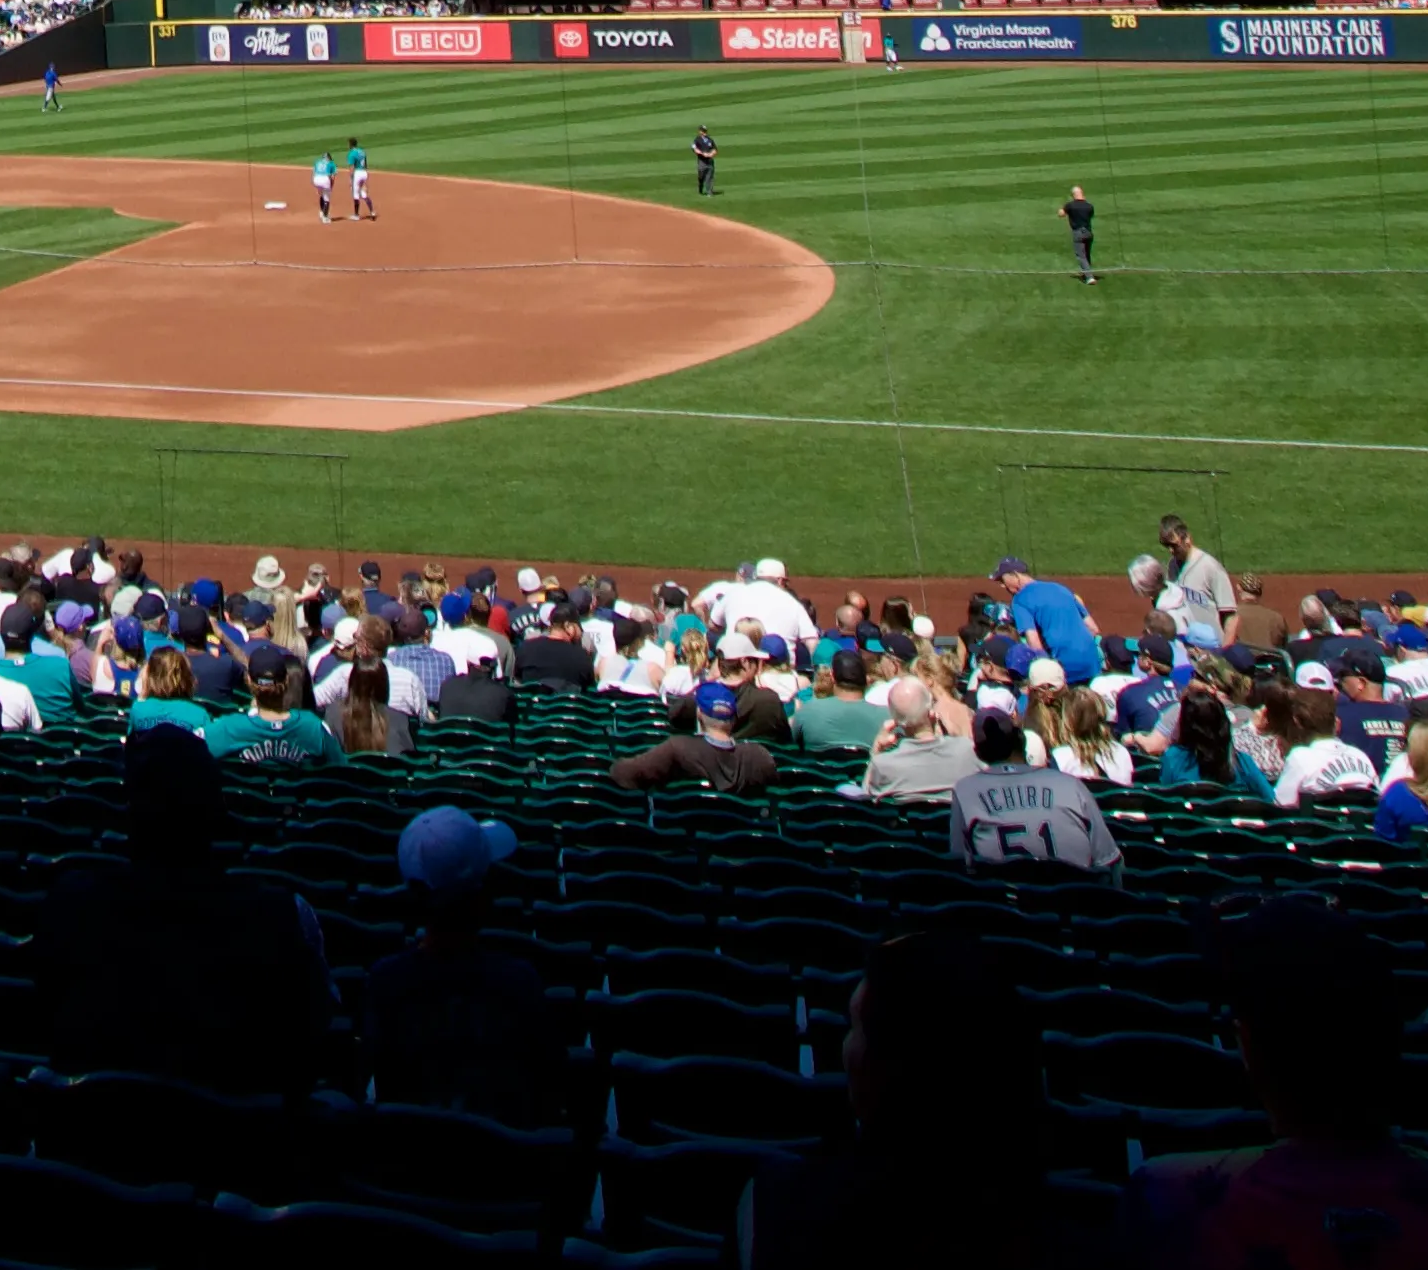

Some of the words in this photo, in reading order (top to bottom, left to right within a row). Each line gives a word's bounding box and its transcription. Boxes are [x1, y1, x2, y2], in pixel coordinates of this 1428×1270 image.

[1111, 14, 1137, 28] 376
[1248, 20, 1331, 36] MARINERS
[1338, 19, 1381, 36] CARE
[158, 25, 176, 38] 331
[953, 23, 1003, 37] Virginia
[1005, 23, 1050, 35] Mason
[594, 31, 674, 47] TOYOTA
[956, 37, 1025, 50] Franciscan
[1249, 37, 1385, 55] FOUNDATION
[978, 784, 1053, 816] ICHIRO
